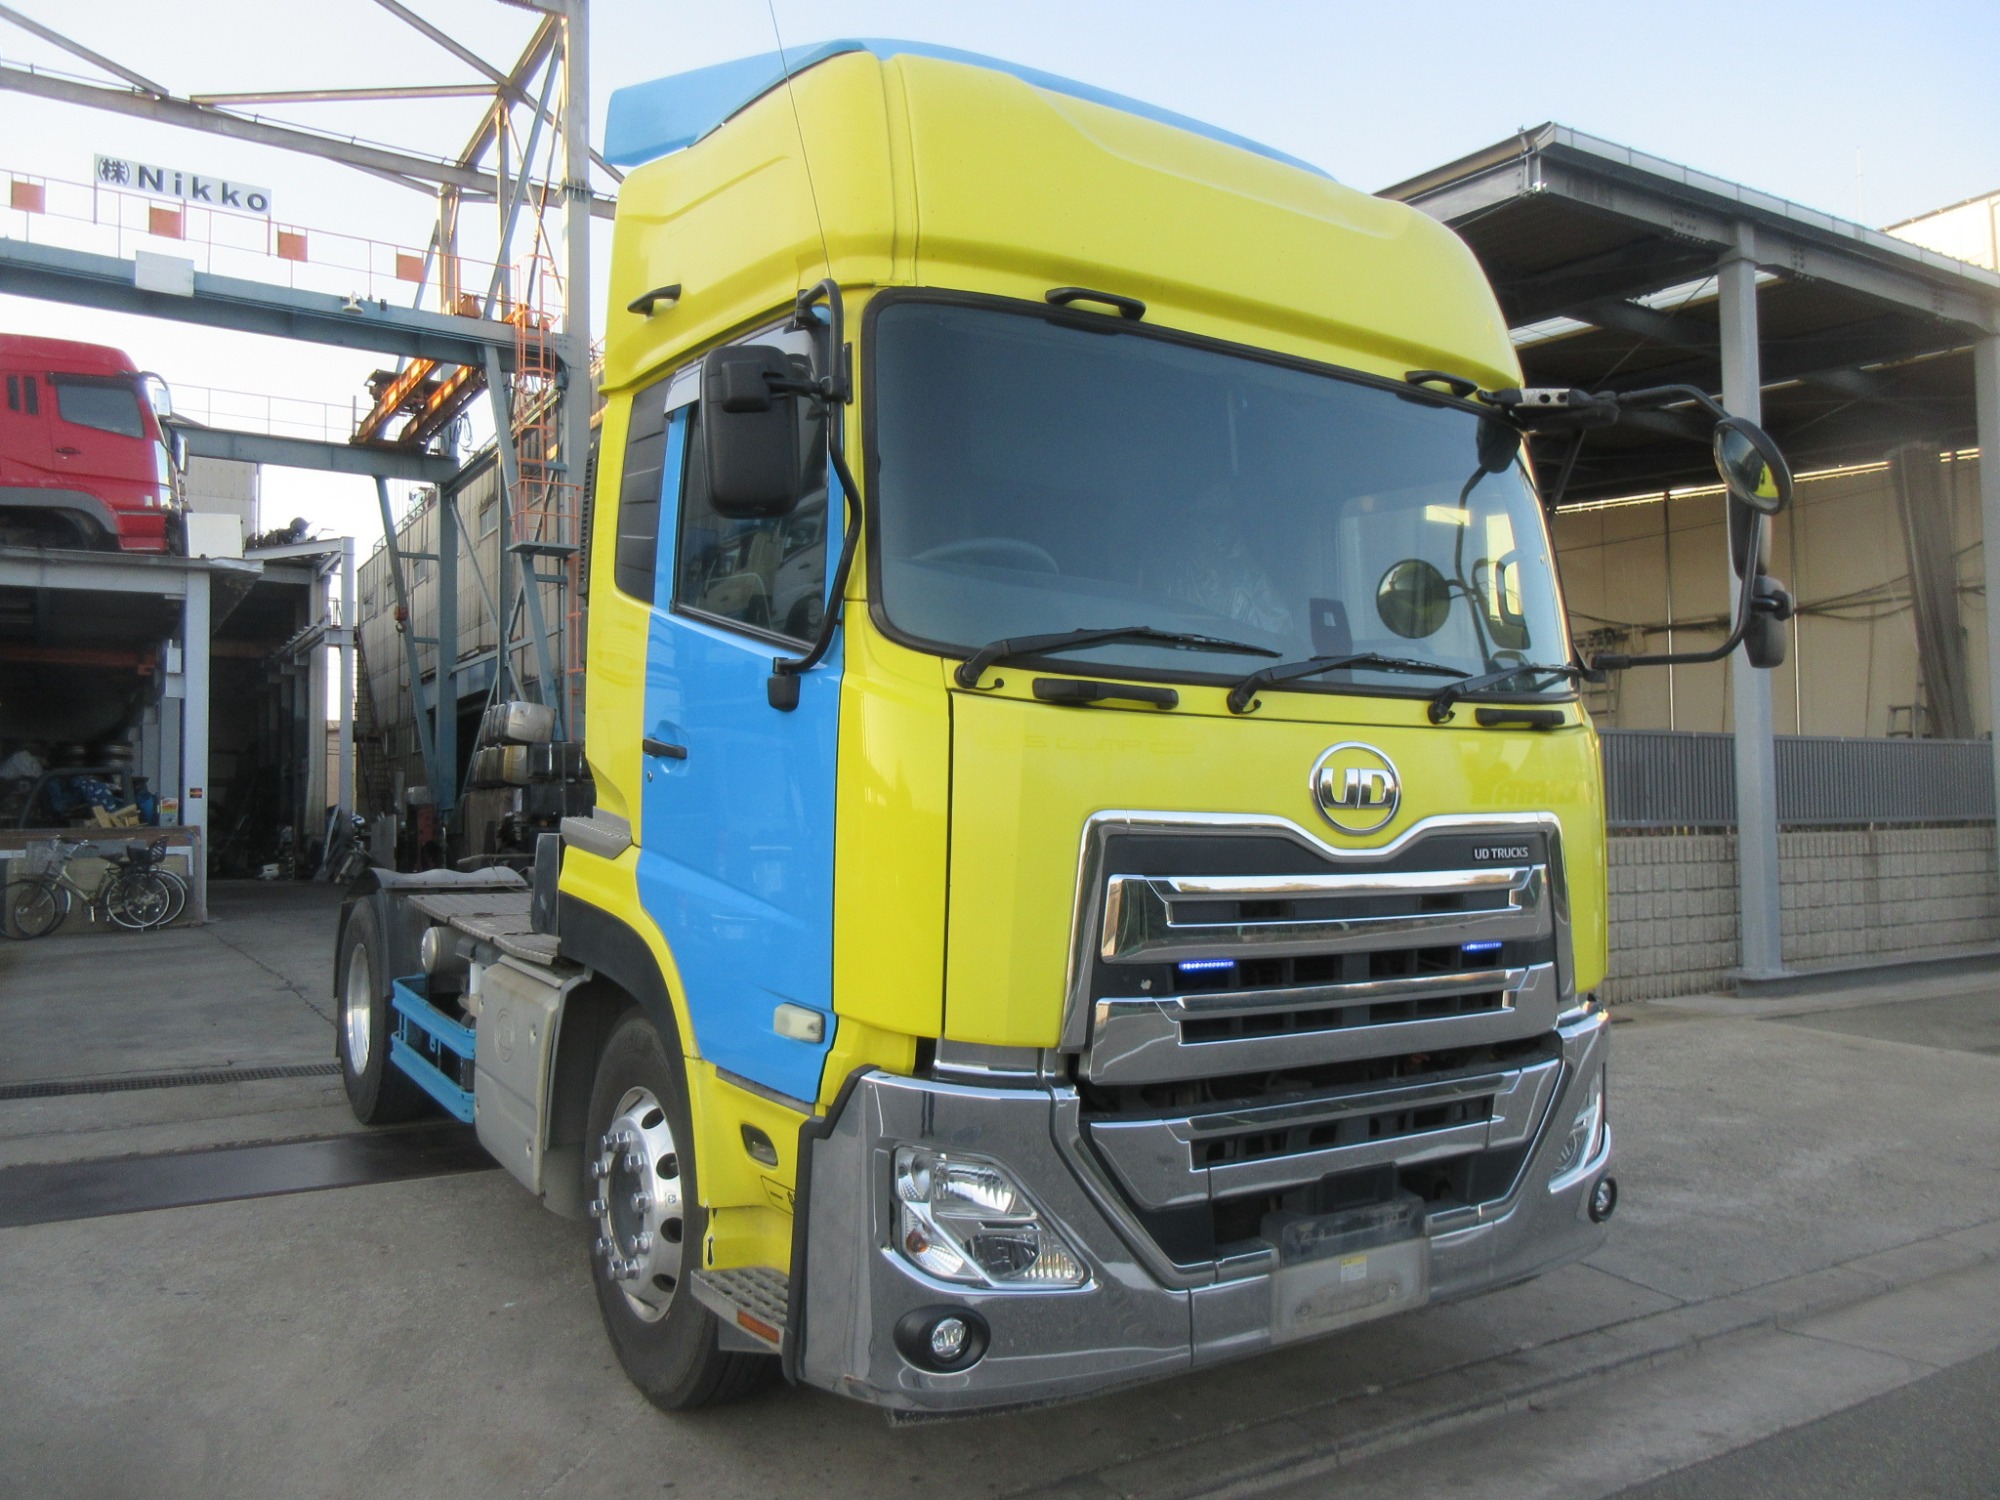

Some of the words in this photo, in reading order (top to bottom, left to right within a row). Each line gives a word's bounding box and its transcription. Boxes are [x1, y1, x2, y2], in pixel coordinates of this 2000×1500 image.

[138, 165, 268, 212] Nikko
[1321, 768, 1397, 809] UD
[1474, 848, 1489, 860] UD
[1491, 846, 1529, 859] TRUCKS
